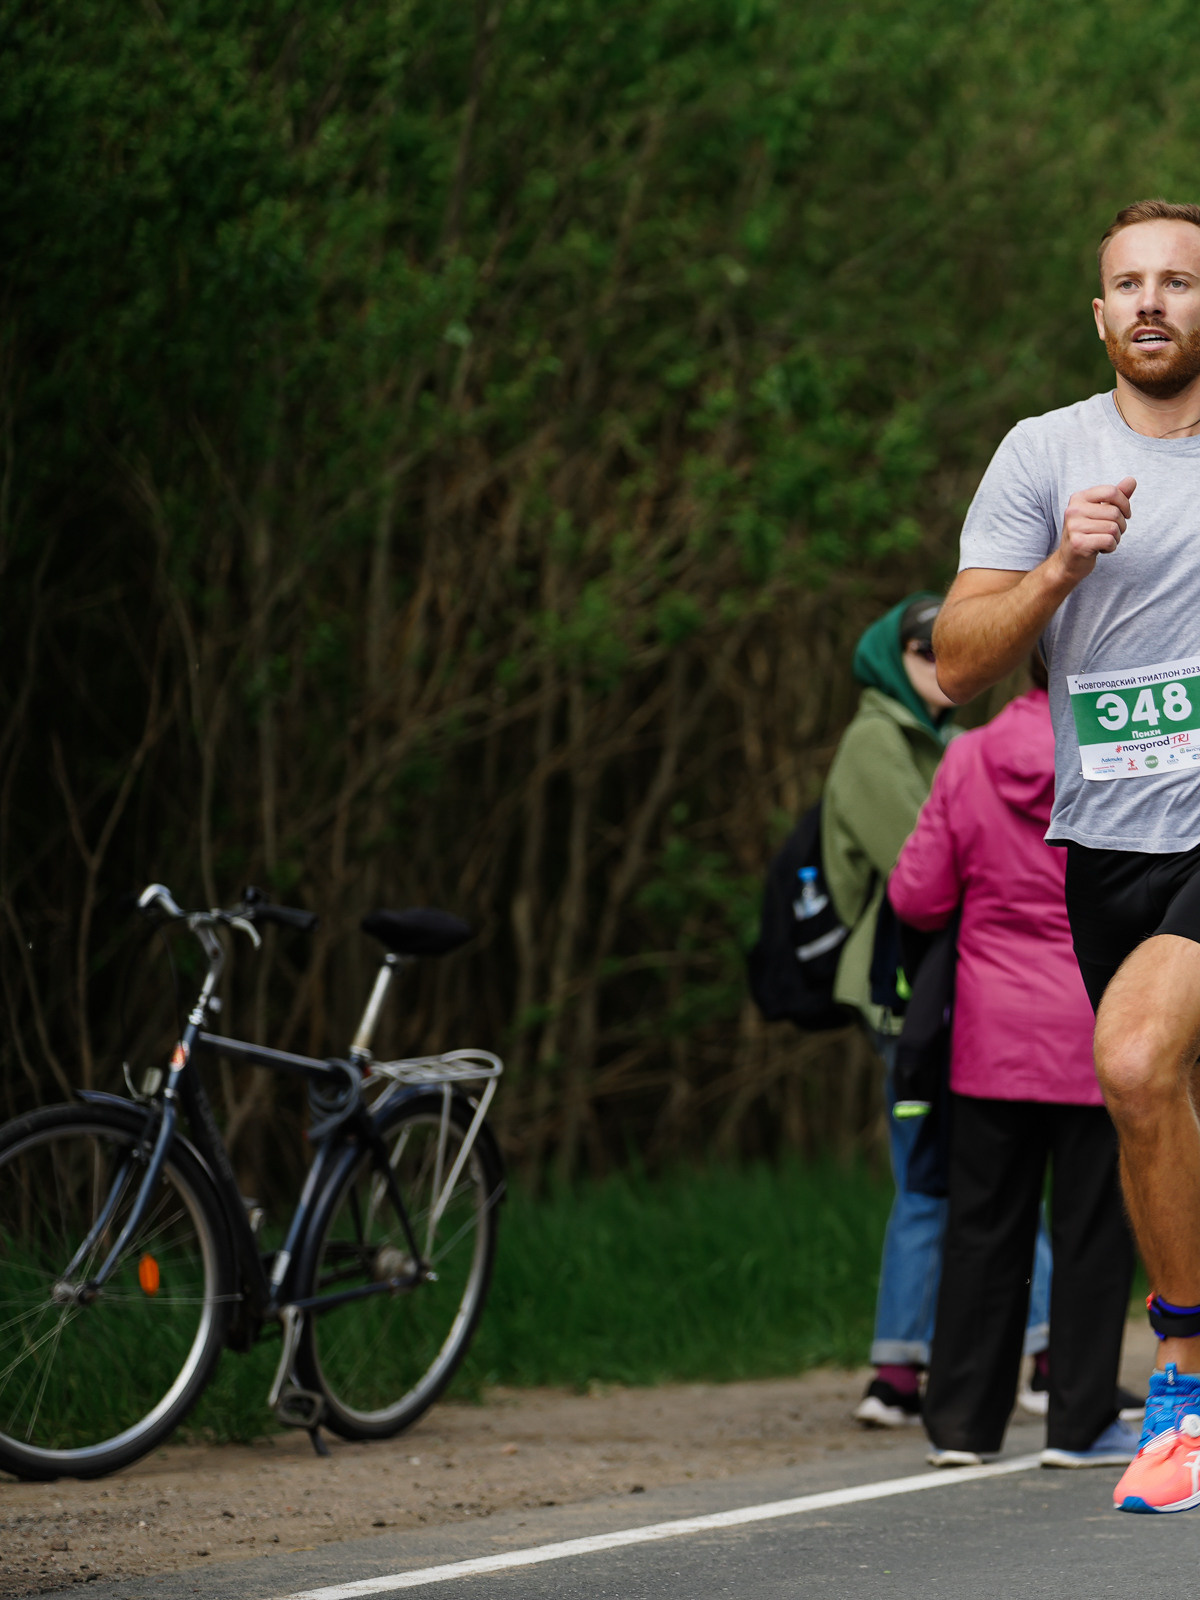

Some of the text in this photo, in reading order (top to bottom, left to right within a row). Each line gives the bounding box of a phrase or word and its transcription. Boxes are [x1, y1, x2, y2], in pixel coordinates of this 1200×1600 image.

[1078, 665, 1200, 690] НОВГОРОДСКИЙ ТРИАТЛОН 2023
[1095, 682, 1192, 731] Э48
[1131, 728, 1161, 739] Психи
